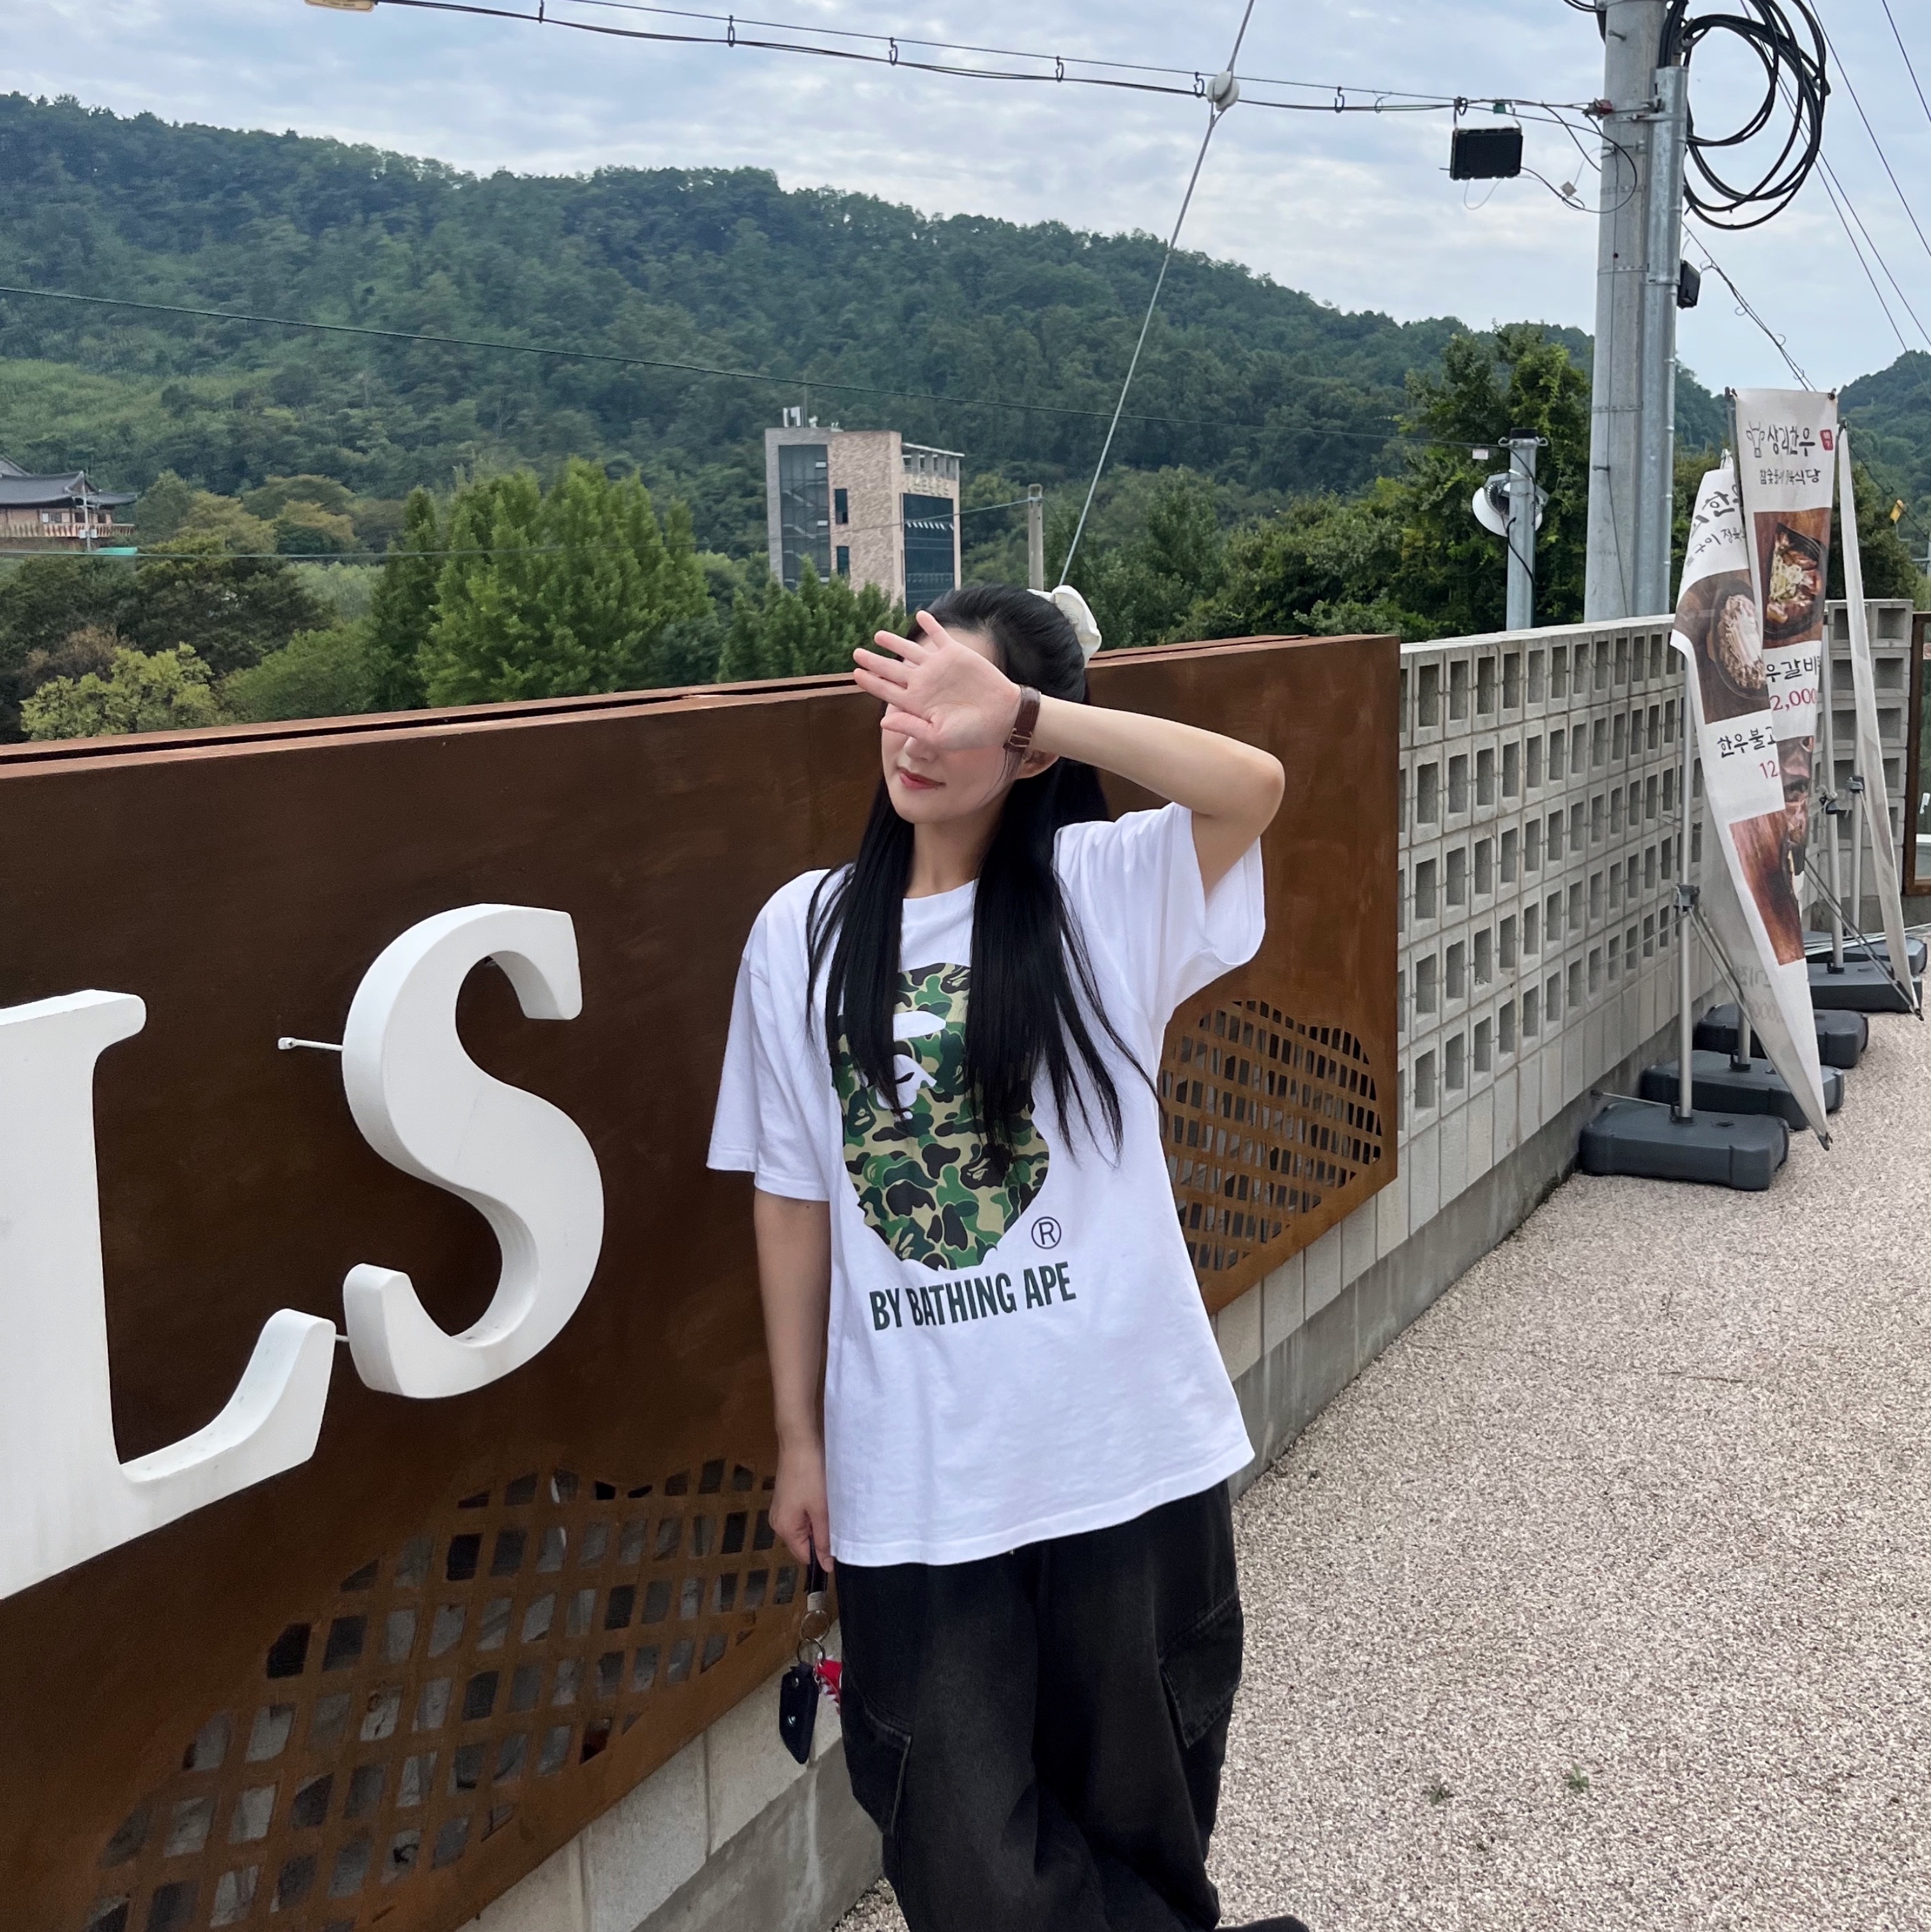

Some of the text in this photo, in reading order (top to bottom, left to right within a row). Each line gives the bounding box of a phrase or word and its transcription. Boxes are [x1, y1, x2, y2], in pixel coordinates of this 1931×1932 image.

[869, 1261, 1076, 1331] BY BATHING APE
